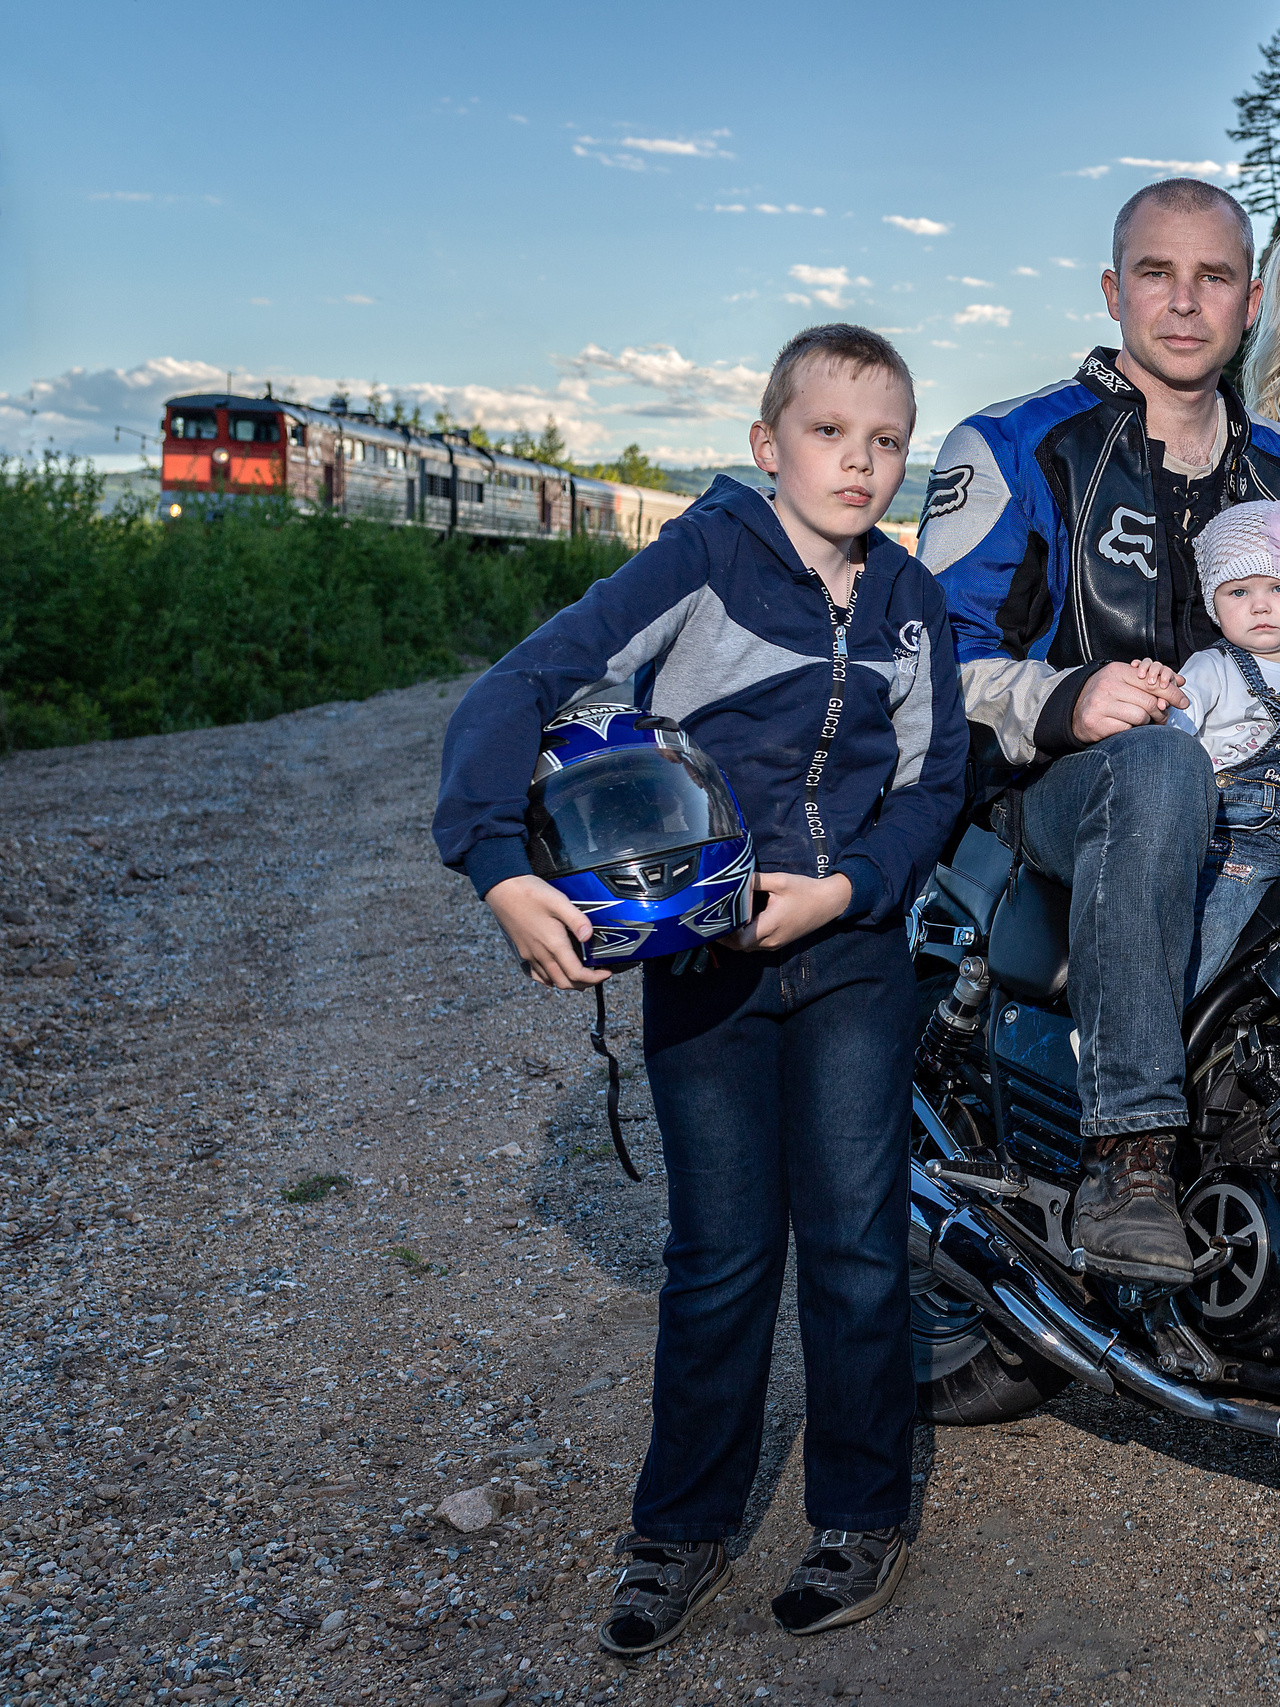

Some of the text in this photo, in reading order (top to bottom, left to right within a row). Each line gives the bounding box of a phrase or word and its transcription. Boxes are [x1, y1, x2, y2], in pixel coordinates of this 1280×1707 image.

[820, 697, 844, 739] GUCCI
[805, 750, 829, 787] GUCCI
[804, 802, 827, 840] GUCCI
